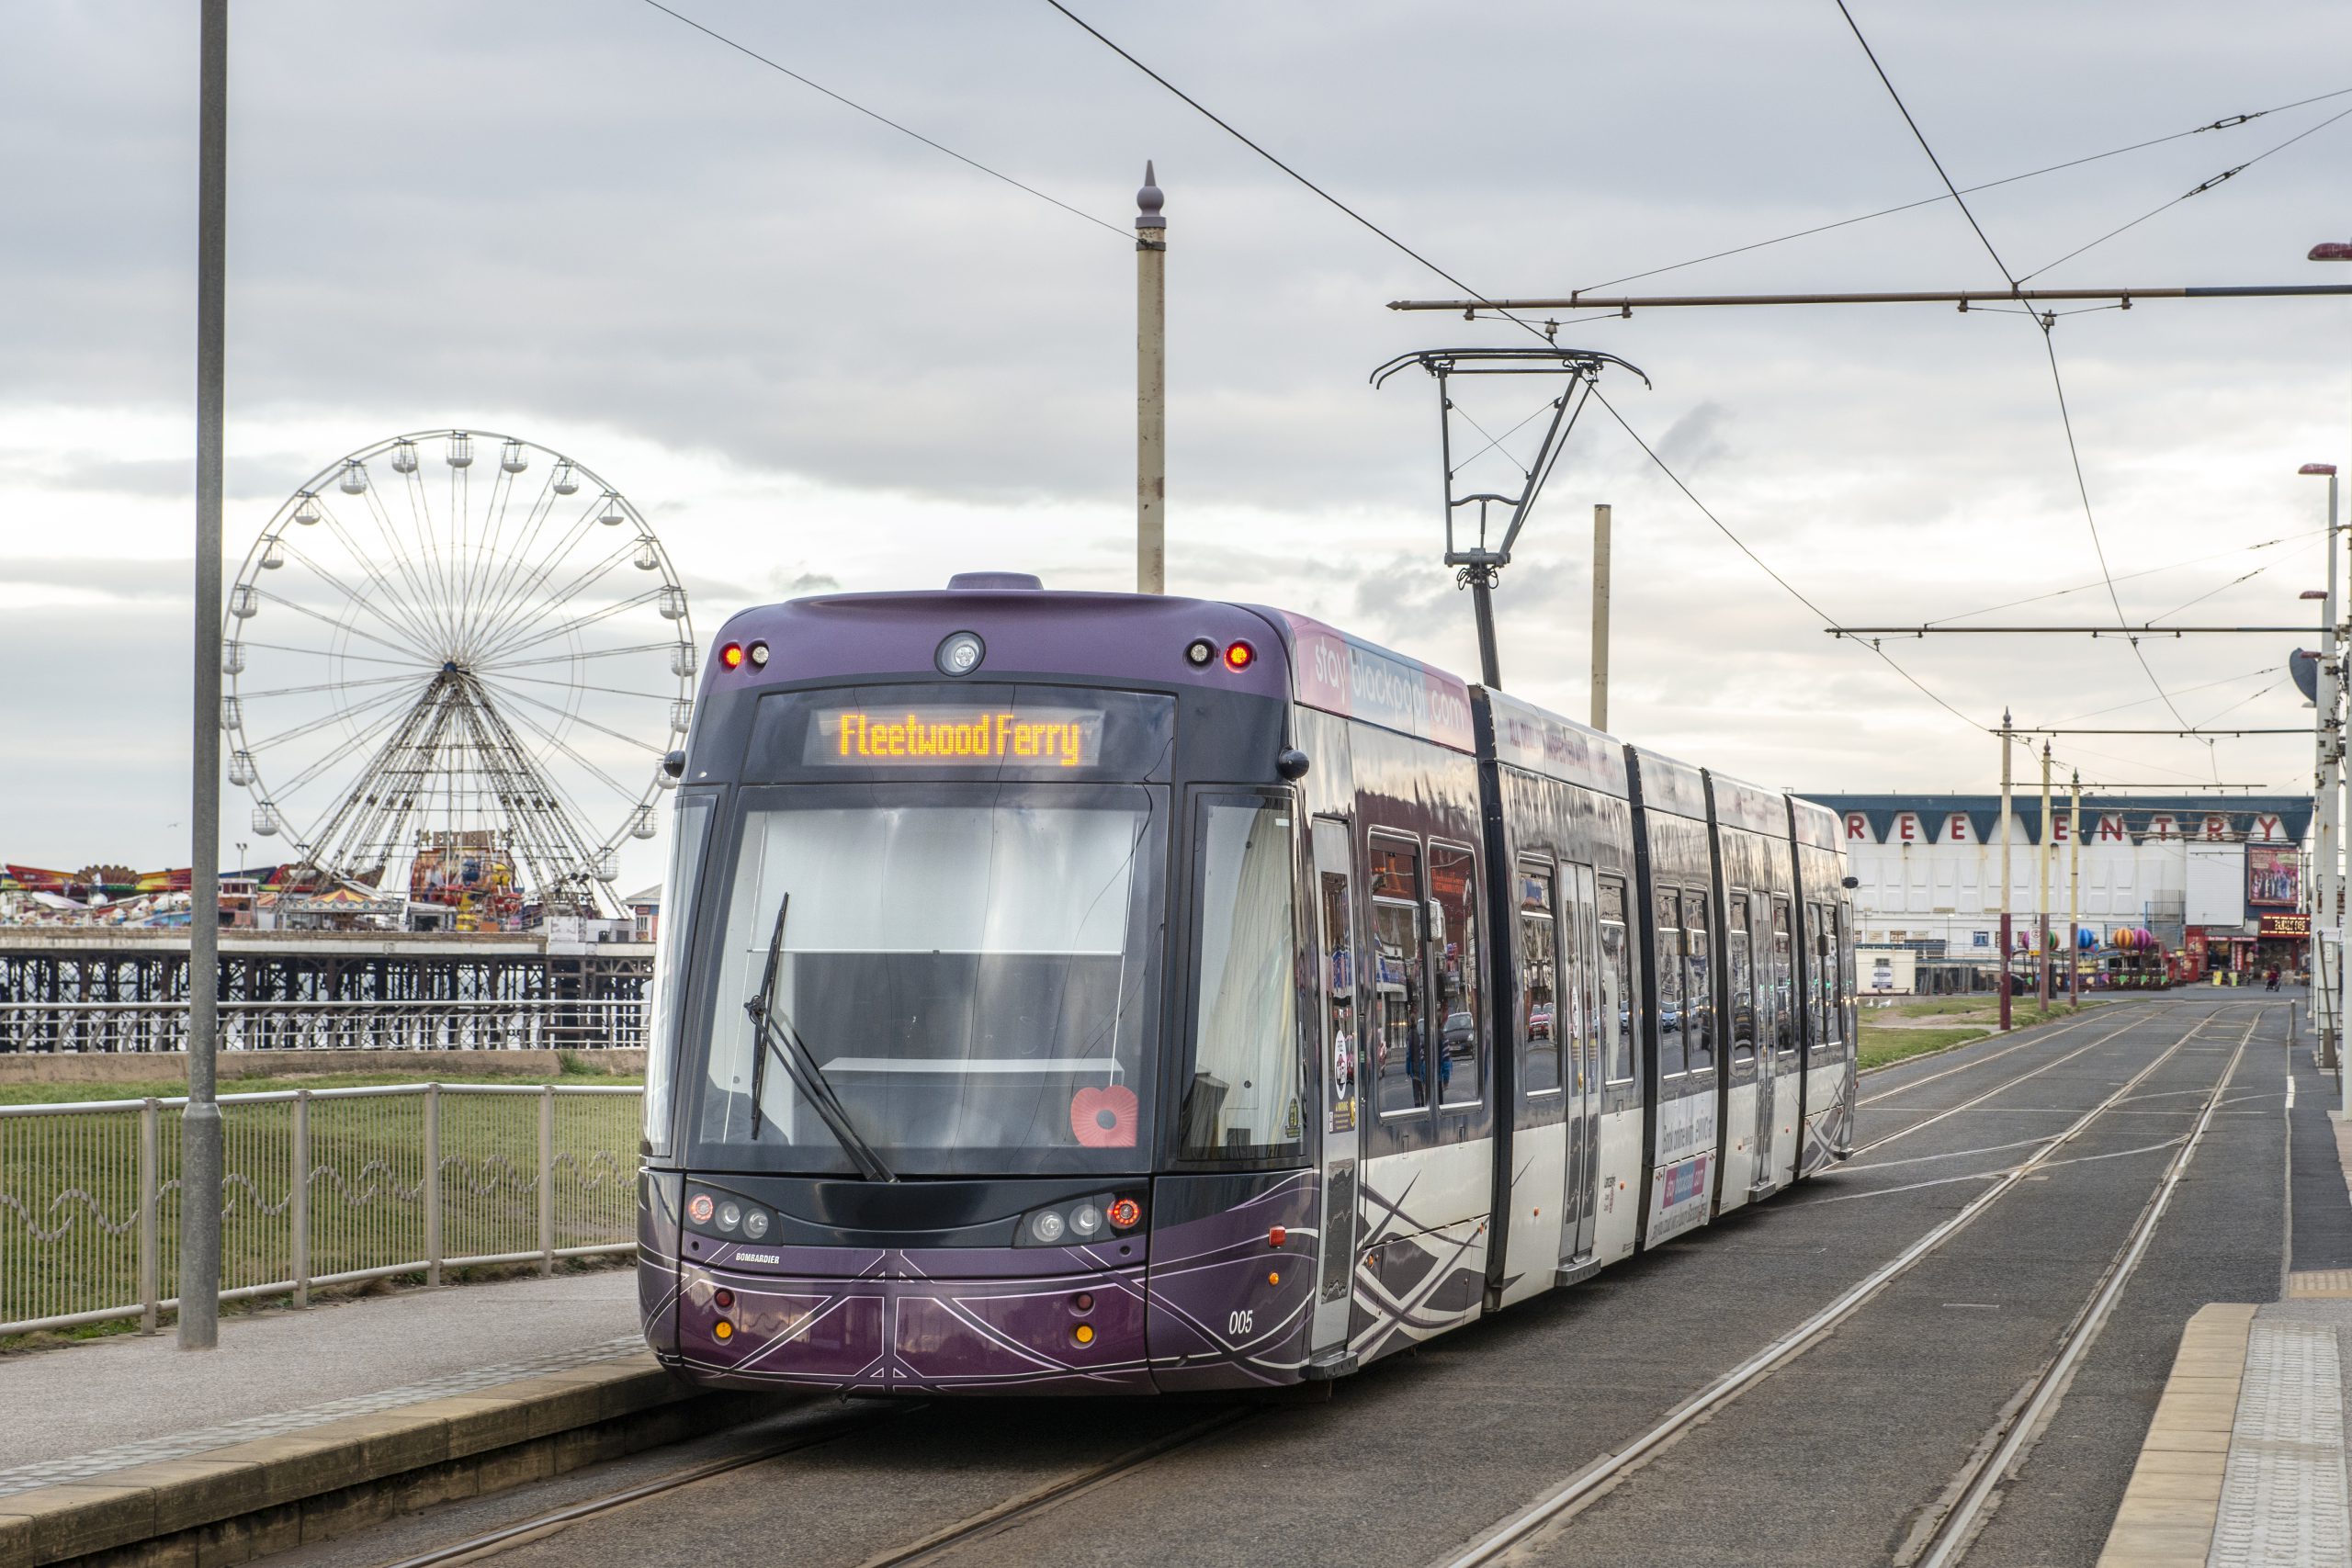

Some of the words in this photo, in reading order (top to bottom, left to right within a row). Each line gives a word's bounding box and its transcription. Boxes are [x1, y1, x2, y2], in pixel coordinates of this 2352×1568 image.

[1315, 636, 1346, 705] stay
[1349, 649, 1426, 722] blackpool
[840, 713, 989, 756] Fleetwood
[997, 713, 1080, 766] Ferry
[1847, 814, 1966, 840] REE
[2052, 814, 2278, 841] ENTRY
[735, 1252, 780, 1265] BOMBARDIER
[1228, 1309, 1253, 1335] 005
